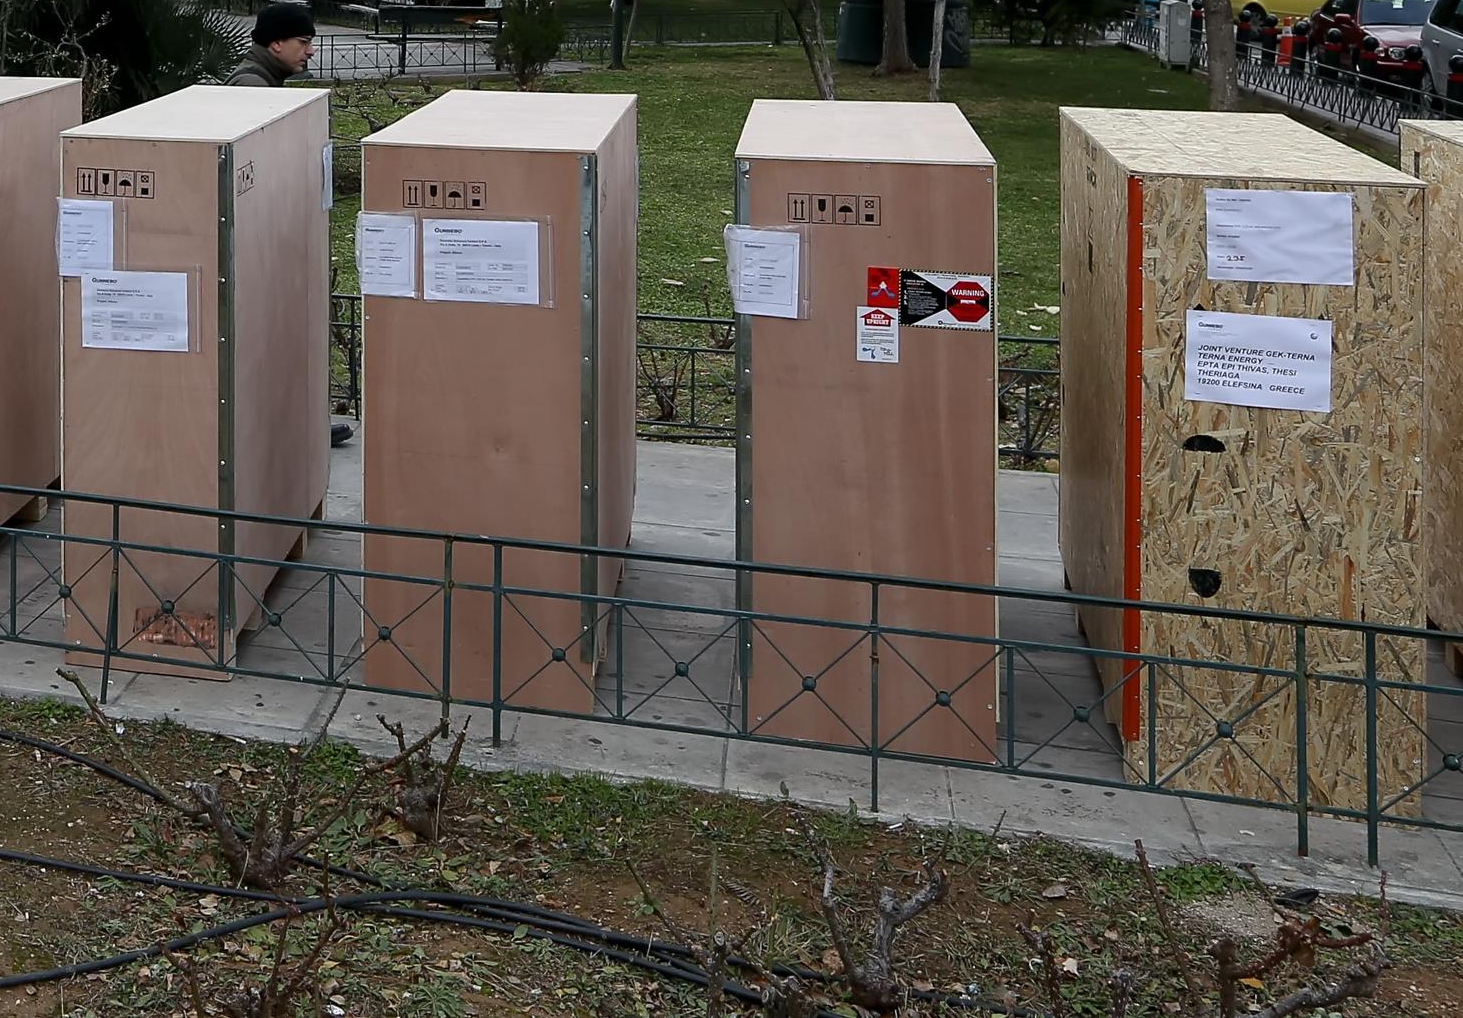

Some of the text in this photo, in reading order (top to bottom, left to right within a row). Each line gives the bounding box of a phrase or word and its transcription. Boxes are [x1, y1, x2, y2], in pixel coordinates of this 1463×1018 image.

[951, 289, 985, 297] WARNING
[1198, 345, 1315, 361] JOINT VENTURE GEK-TERNA
[1198, 352, 1263, 364] TERNA ENERGY
[1197, 361, 1219, 369] EPTA
[1237, 364, 1269, 374] THIVAS,
[1272, 368, 1297, 376] THESI
[1198, 369, 1240, 379] THERIAGA
[1197, 378, 1305, 394] 19200 ELEFSINA GREECE
